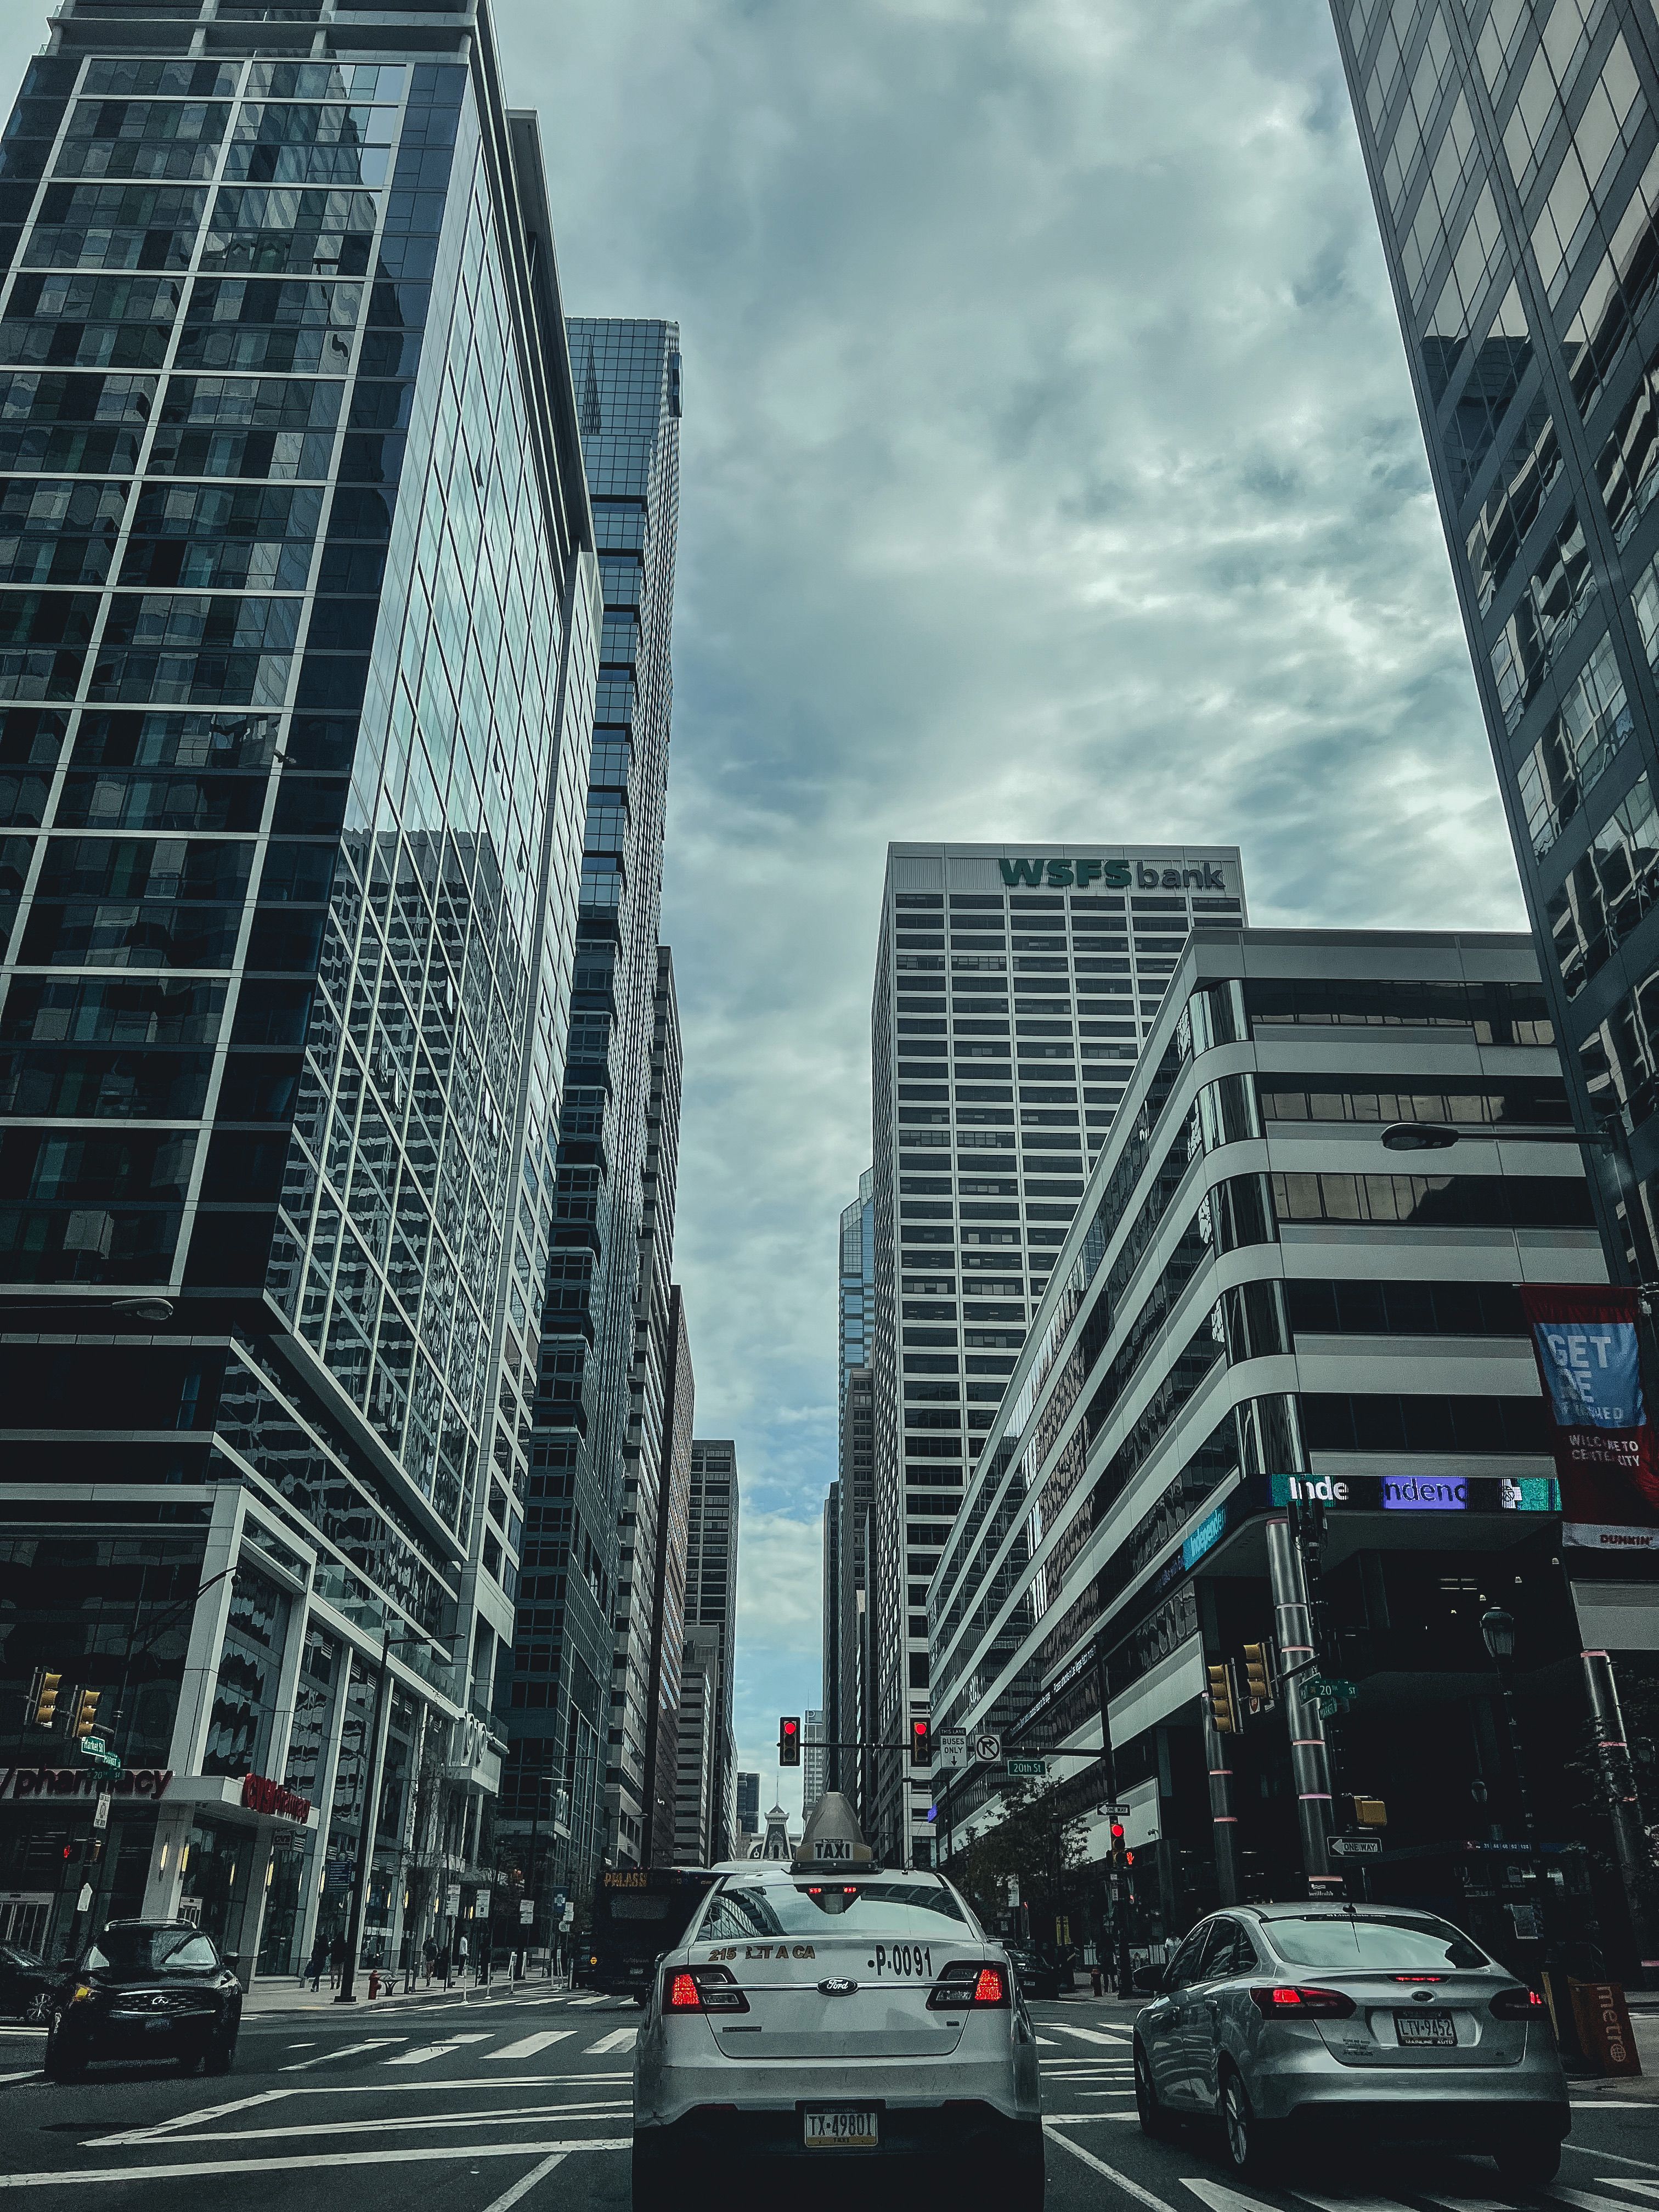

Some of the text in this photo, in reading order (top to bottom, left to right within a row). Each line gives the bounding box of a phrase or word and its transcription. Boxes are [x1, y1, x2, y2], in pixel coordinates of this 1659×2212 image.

[997, 858, 1226, 888] WSFS bank
[1548, 1334, 1611, 1368] GET
[1622, 1441, 1639, 1452] TO
[807, 1711, 816, 1723] P
[1013, 1763, 1041, 1773] 20th St
[815, 1843, 850, 1859] TAXI
[1360, 1843, 1376, 1852] WAY
[708, 1946, 737, 1962] 215
[775, 1945, 789, 1959] A
[792, 1945, 816, 1959] CA
[827, 1979, 849, 1989] Ford
